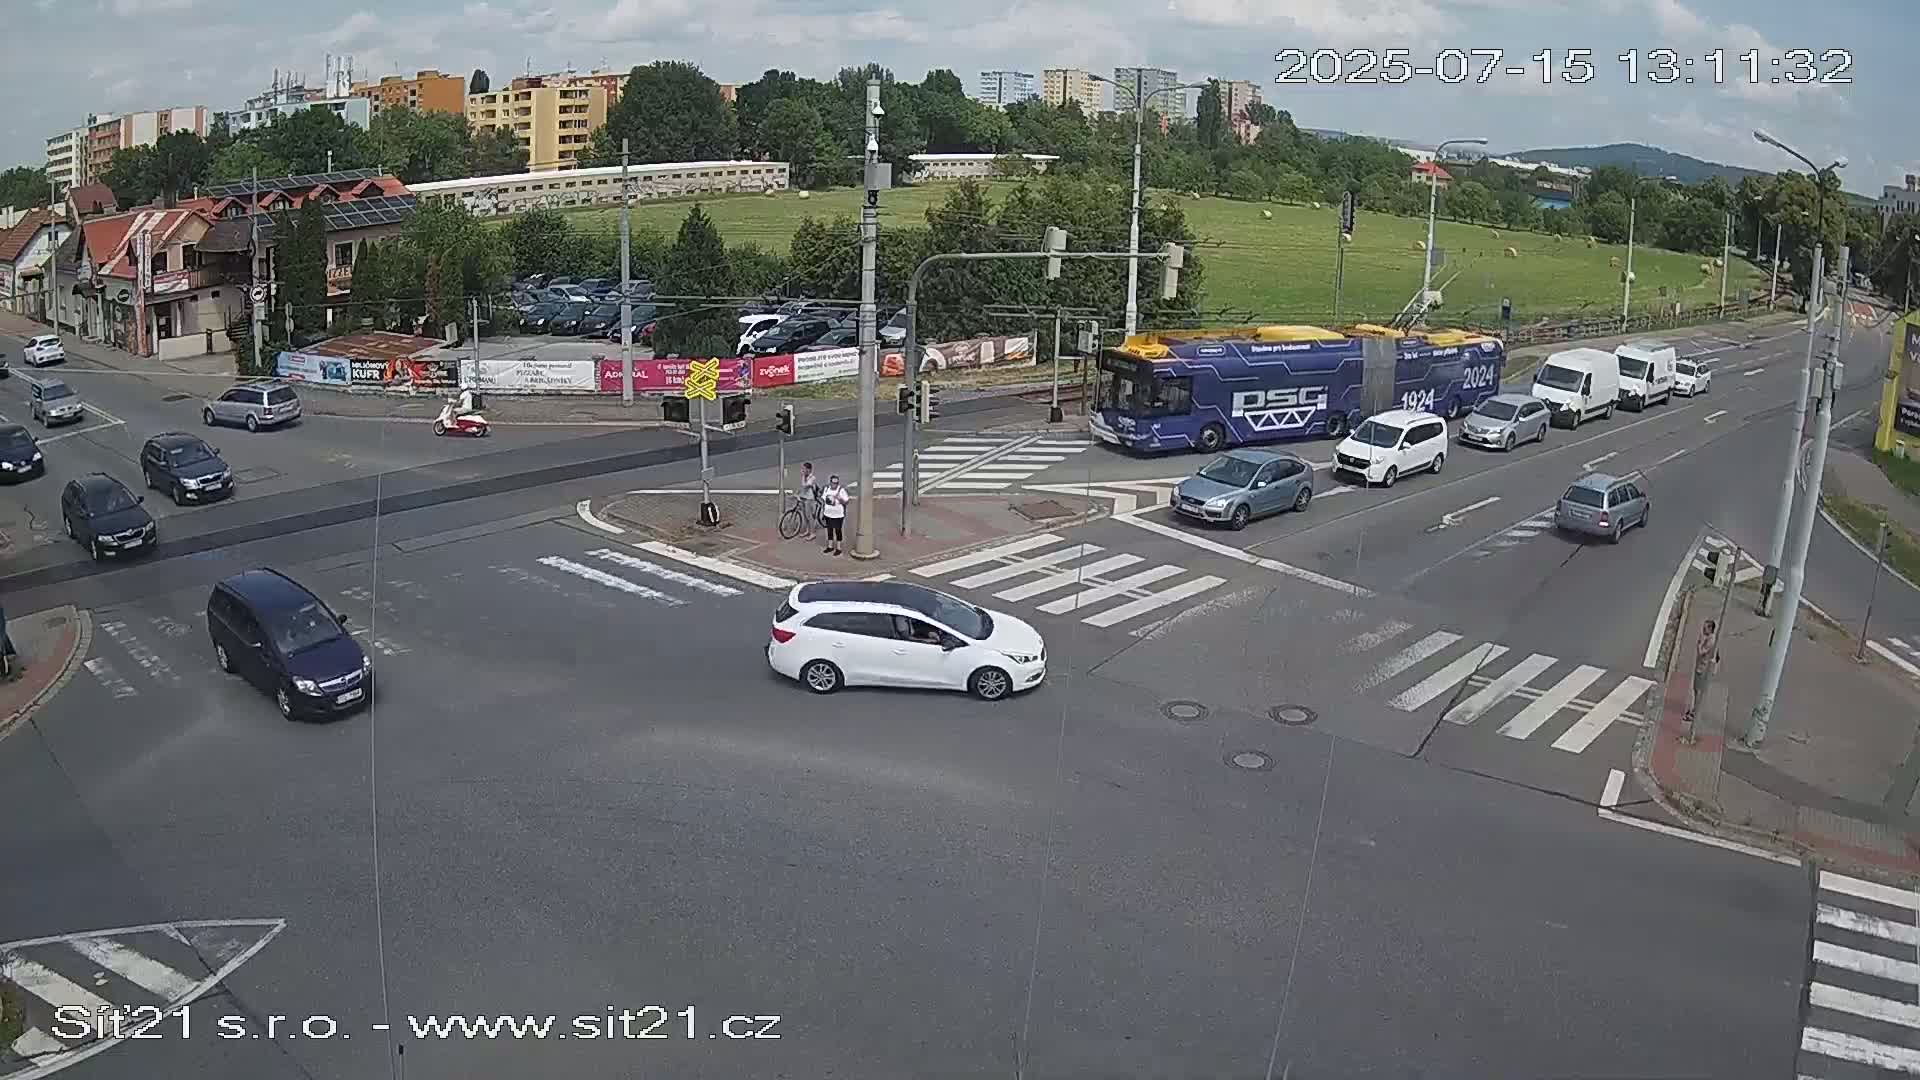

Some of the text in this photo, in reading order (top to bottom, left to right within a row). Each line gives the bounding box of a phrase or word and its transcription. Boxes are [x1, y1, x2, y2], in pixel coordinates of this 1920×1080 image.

[352, 369, 380, 380] KUFR
[1462, 364, 1495, 390] 2024
[1231, 385, 1329, 418] PSG
[1400, 388, 1436, 412] 1924
